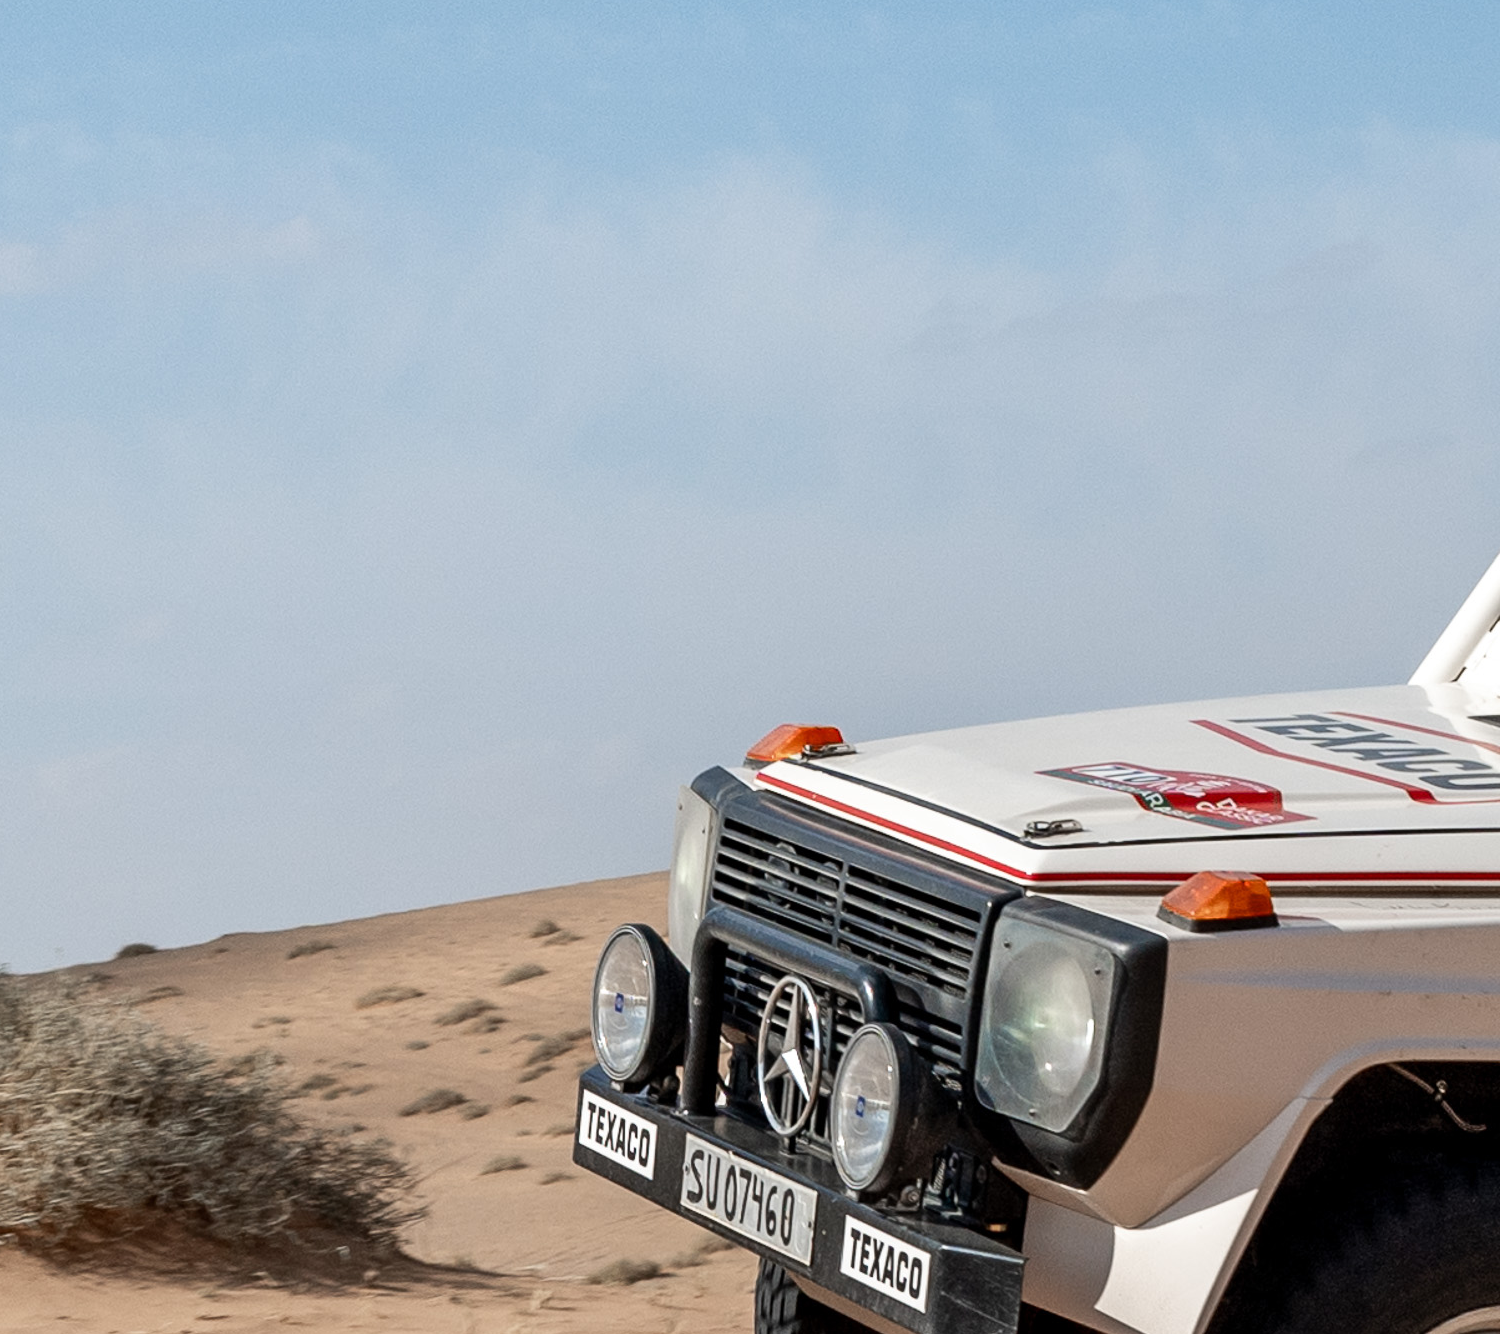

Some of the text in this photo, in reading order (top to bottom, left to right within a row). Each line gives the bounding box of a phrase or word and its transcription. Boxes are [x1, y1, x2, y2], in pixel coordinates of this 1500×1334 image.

[587, 1101, 652, 1168] TEXACO
[686, 1149, 720, 1211] SU
[849, 1227, 923, 1300] TEXACO
